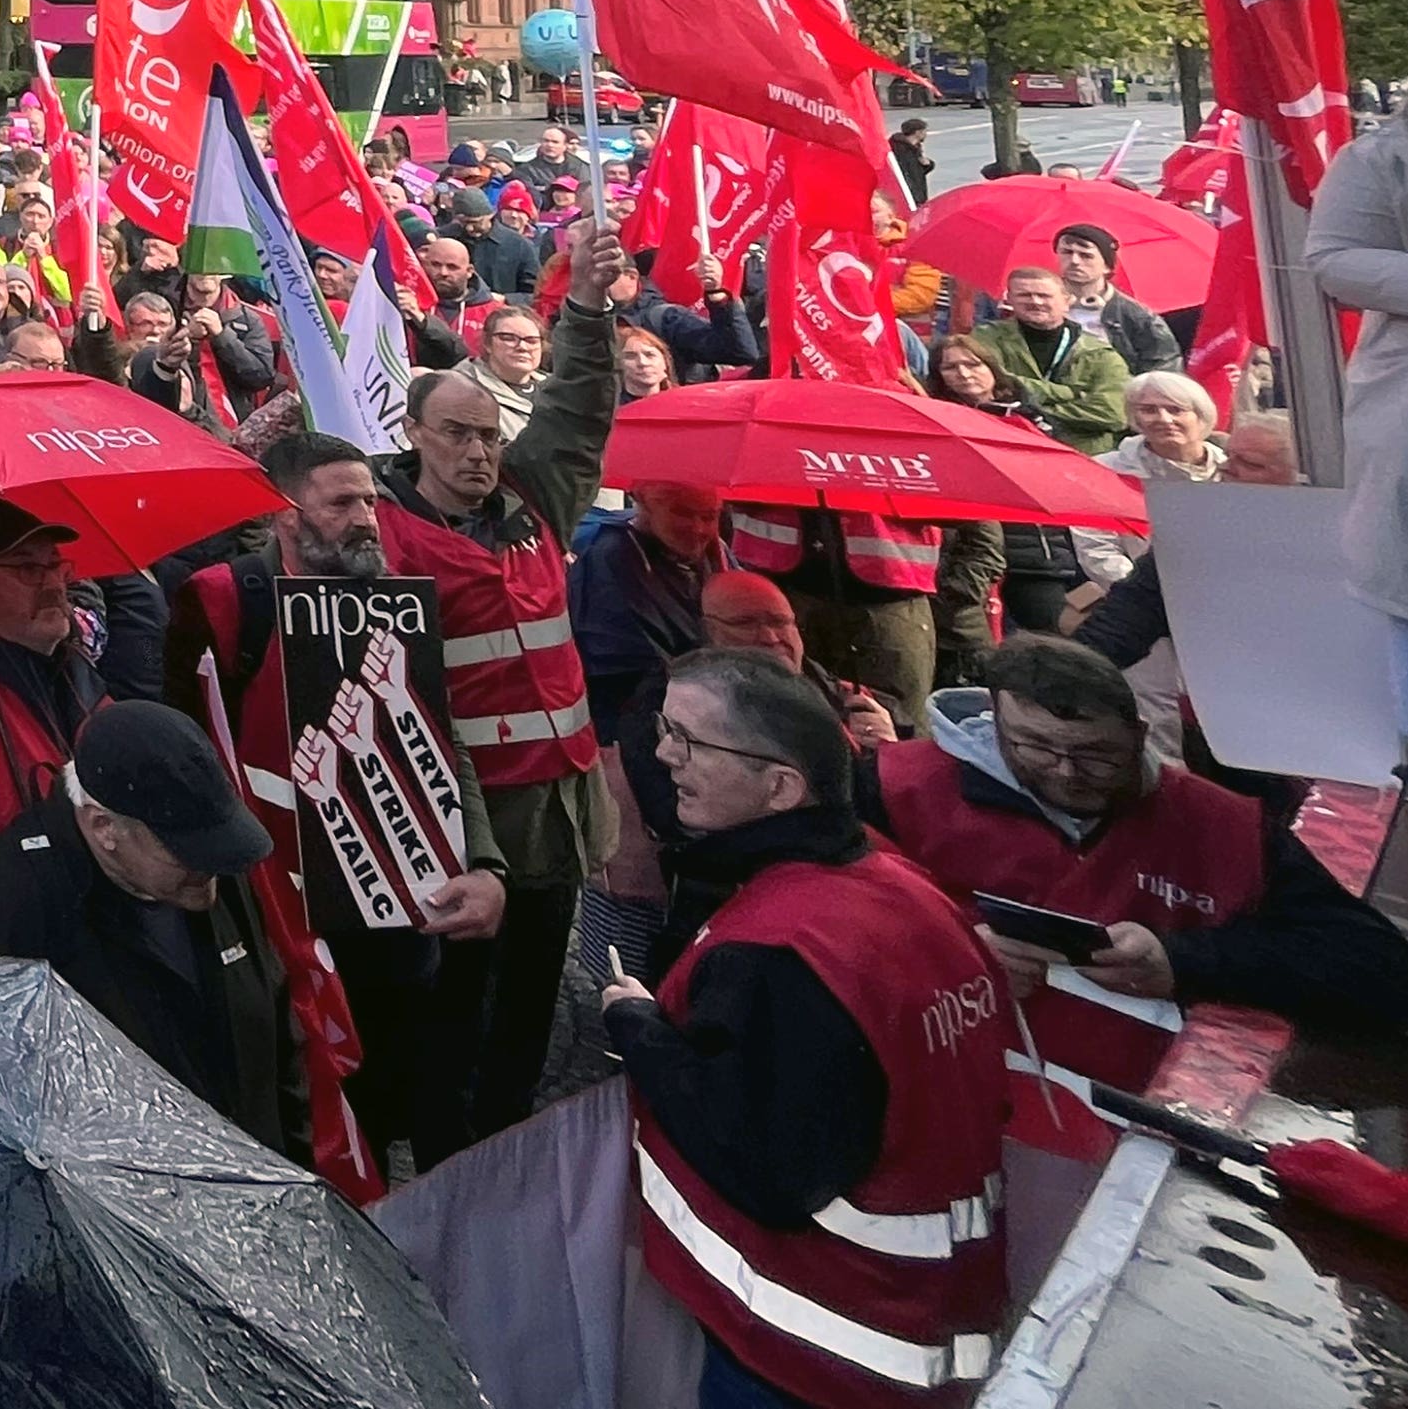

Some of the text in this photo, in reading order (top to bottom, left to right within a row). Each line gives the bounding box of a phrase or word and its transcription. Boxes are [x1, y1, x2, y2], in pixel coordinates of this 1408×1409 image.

[26, 425, 161, 466] nipsa
[796, 448, 933, 480] MTB
[282, 584, 428, 672] nipsa
[395, 710, 463, 821] STRYK
[320, 795, 395, 922] STAILC
[359, 752, 437, 883] STRIKE
[921, 974, 998, 1056] nipsa
